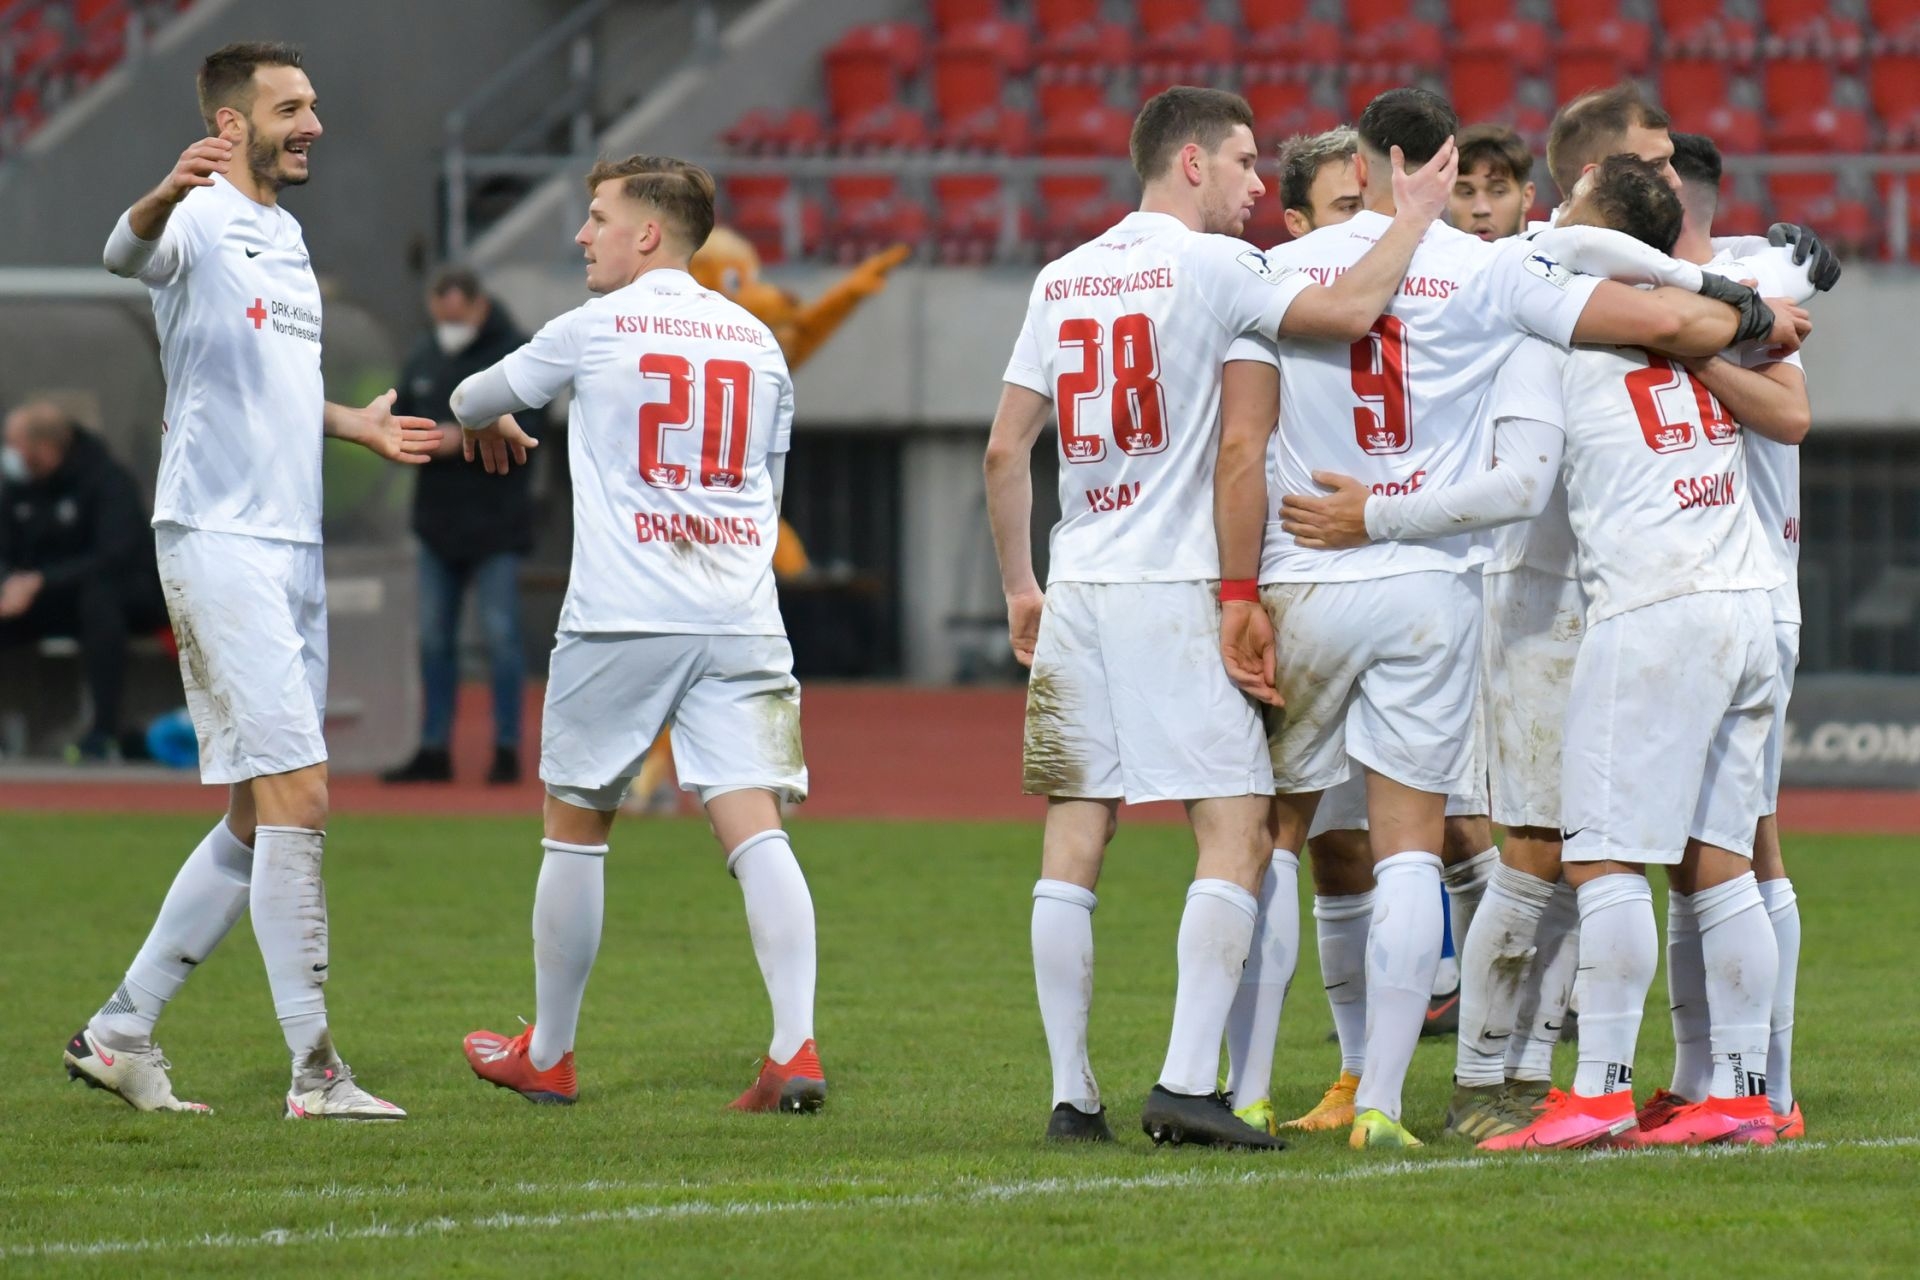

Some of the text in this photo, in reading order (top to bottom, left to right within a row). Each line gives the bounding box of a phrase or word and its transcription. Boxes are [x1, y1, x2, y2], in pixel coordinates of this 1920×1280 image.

[1045, 279, 1072, 301] KSV
[1124, 268, 1174, 294] KASSEL
[615, 314, 767, 348] KSV HESSEN KASSEL
[1057, 313, 1169, 464] 28
[1351, 314, 1413, 456] 9
[638, 353, 755, 493] 20
[1674, 471, 1735, 510] SAGLIK
[634, 512, 761, 546] BRANDNER
